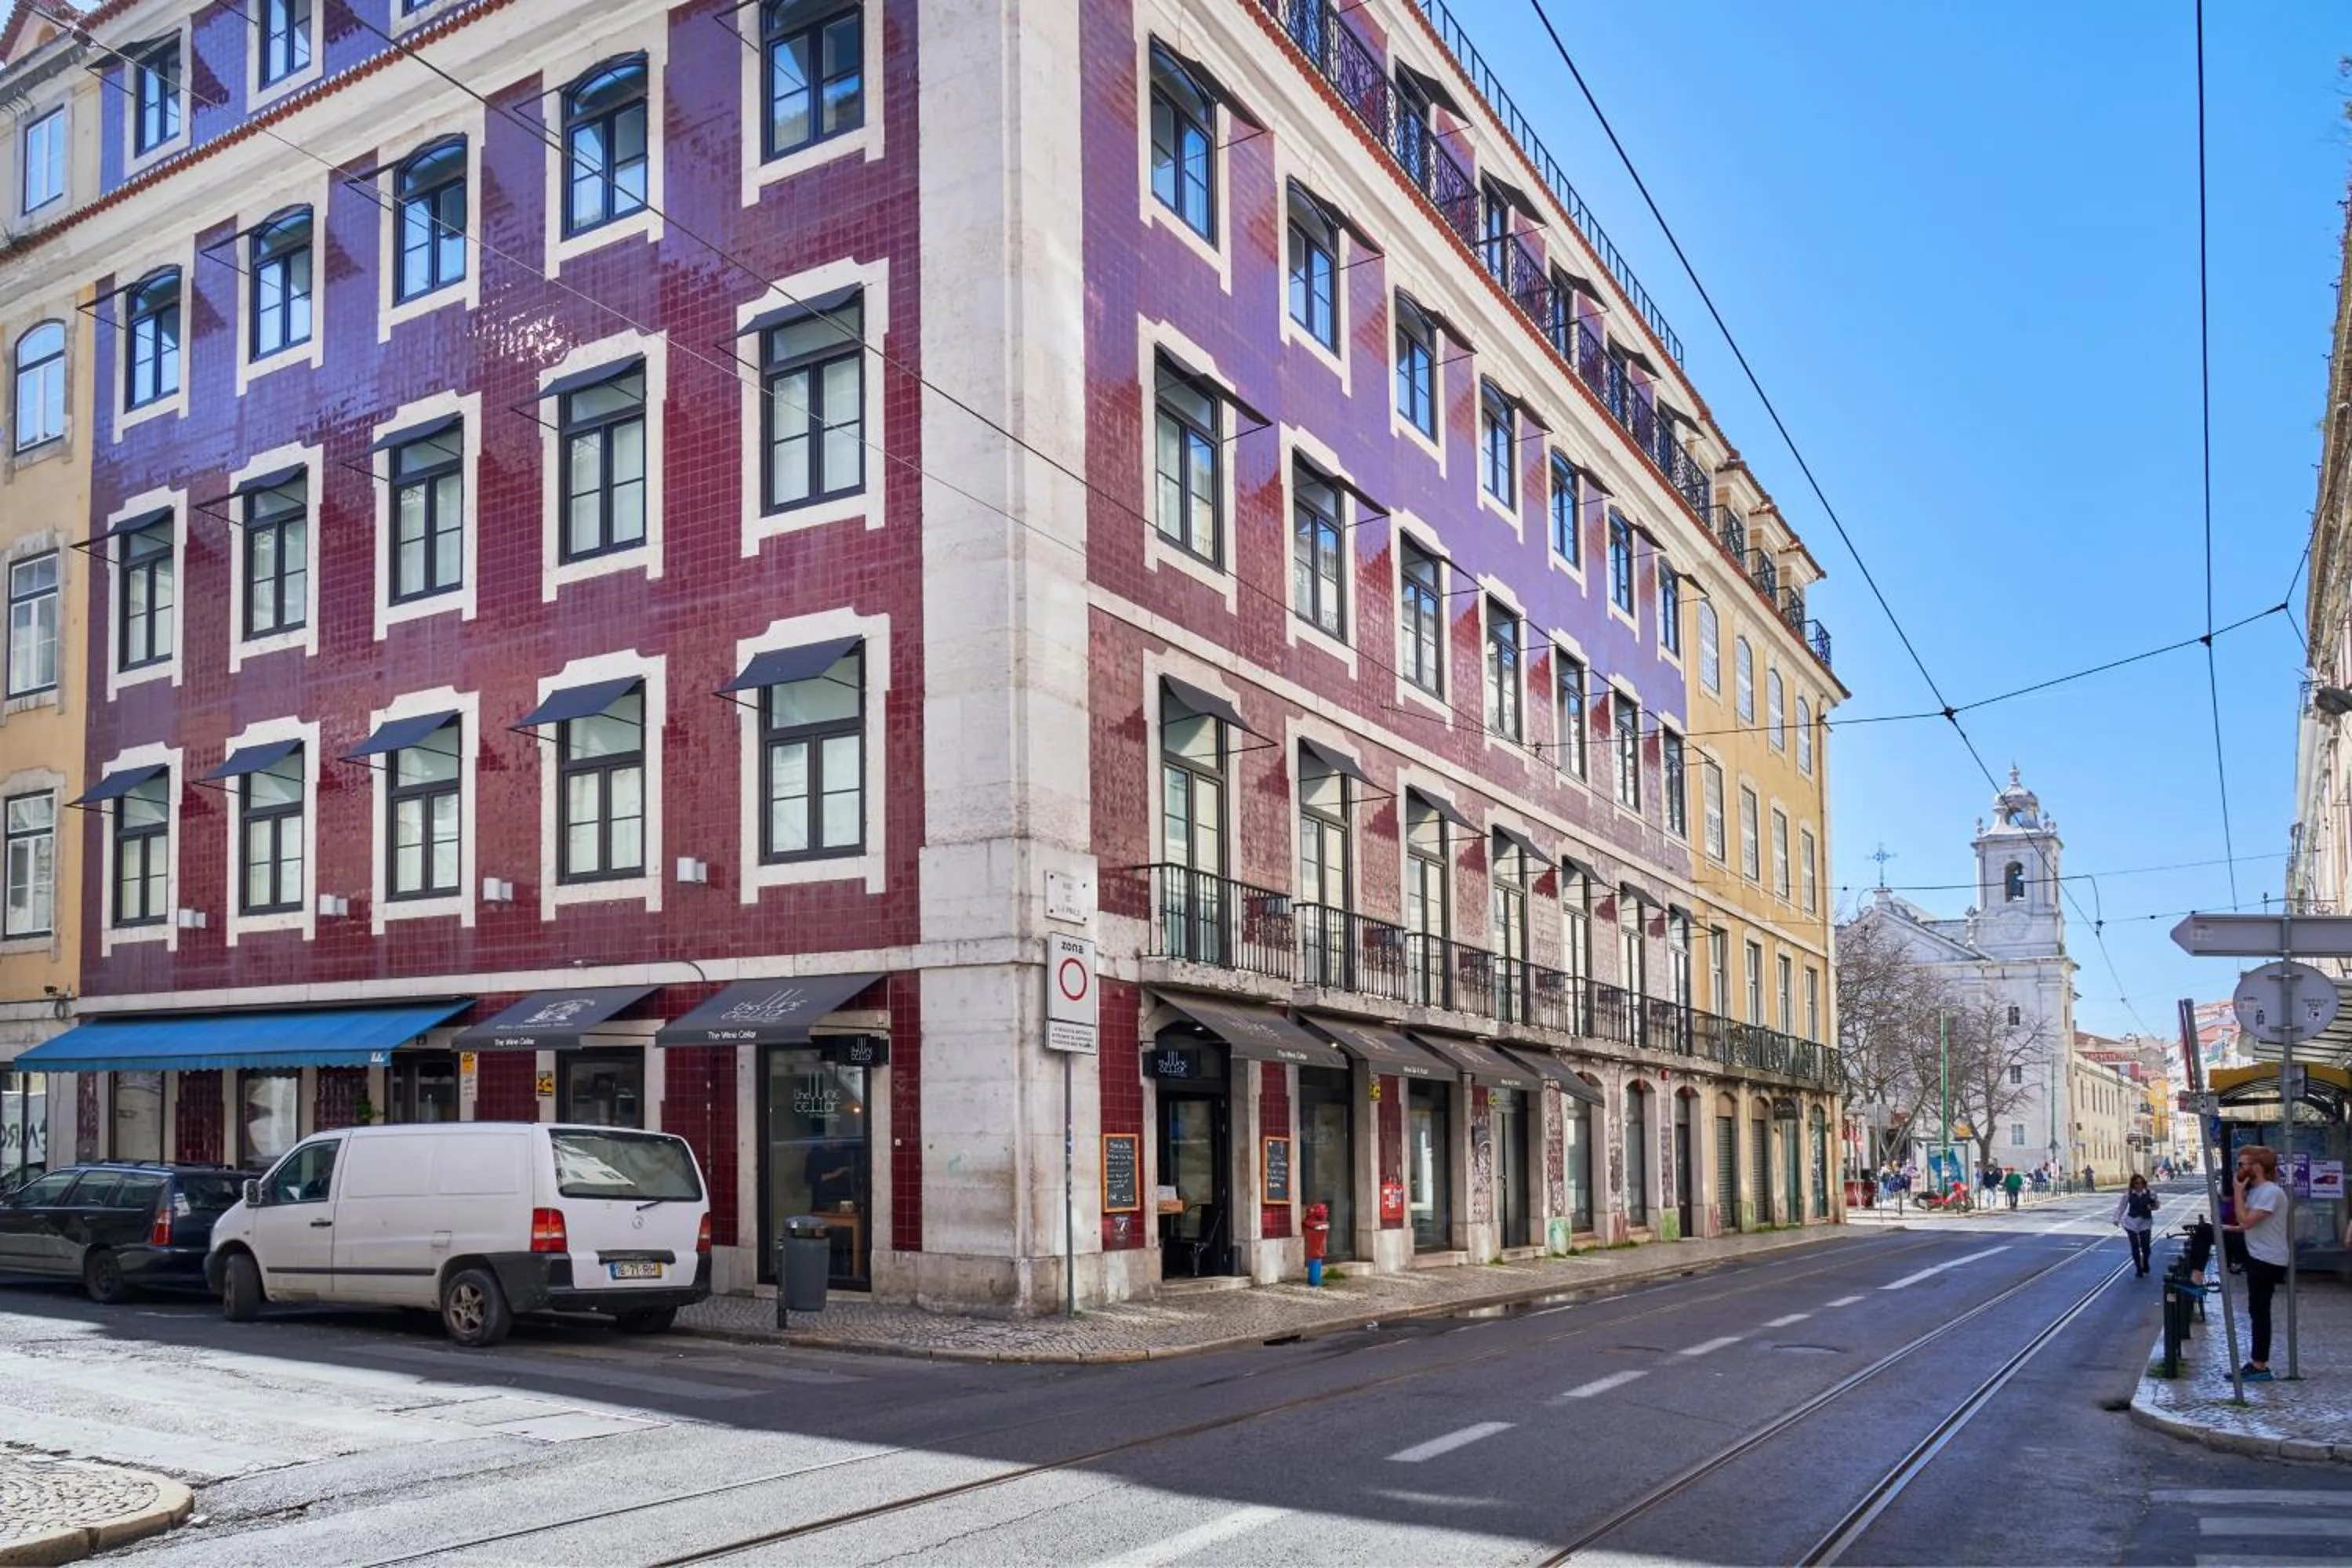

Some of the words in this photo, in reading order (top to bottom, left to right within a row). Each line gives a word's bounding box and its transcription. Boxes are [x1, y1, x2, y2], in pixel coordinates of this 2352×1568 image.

[1062, 941, 1083, 954] zona
[707, 1031, 720, 1040] The
[738, 1029, 757, 1039] Cellar
